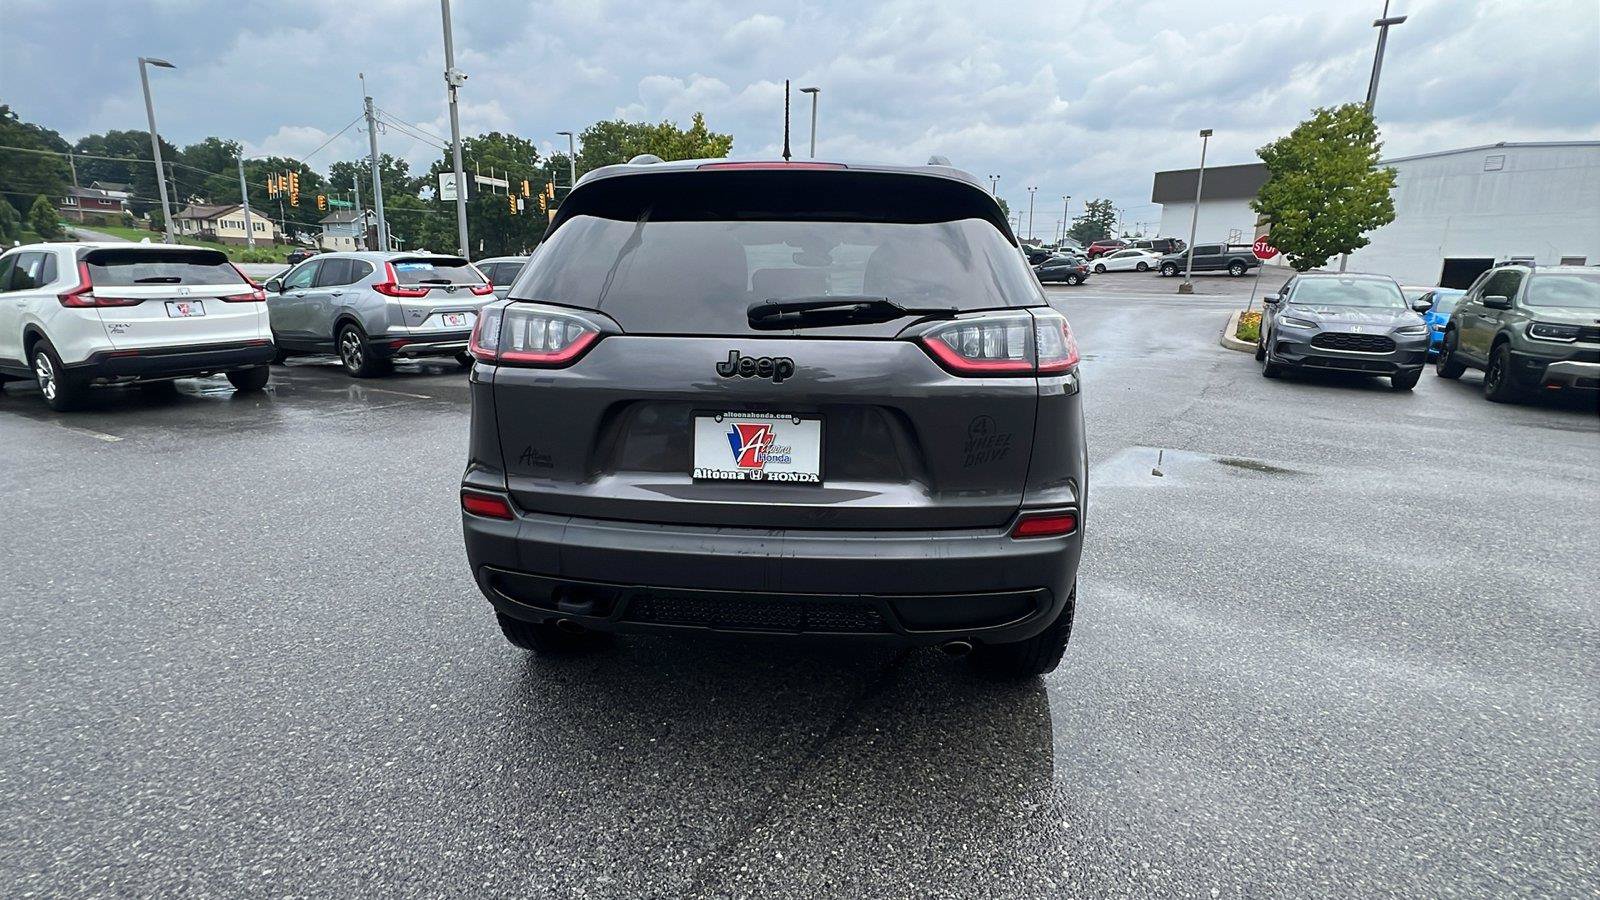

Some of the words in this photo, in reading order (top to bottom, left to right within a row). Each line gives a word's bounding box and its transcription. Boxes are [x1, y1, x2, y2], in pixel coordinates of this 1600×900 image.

[715, 349, 795, 384] Jeep
[723, 411, 792, 420] altoonahonda.com
[964, 433, 1012, 453] WHEEL
[758, 452, 791, 464] Honda
[963, 447, 1011, 467] DRIVE
[693, 468, 745, 480] Altoona
[768, 473, 820, 482] HONDA
